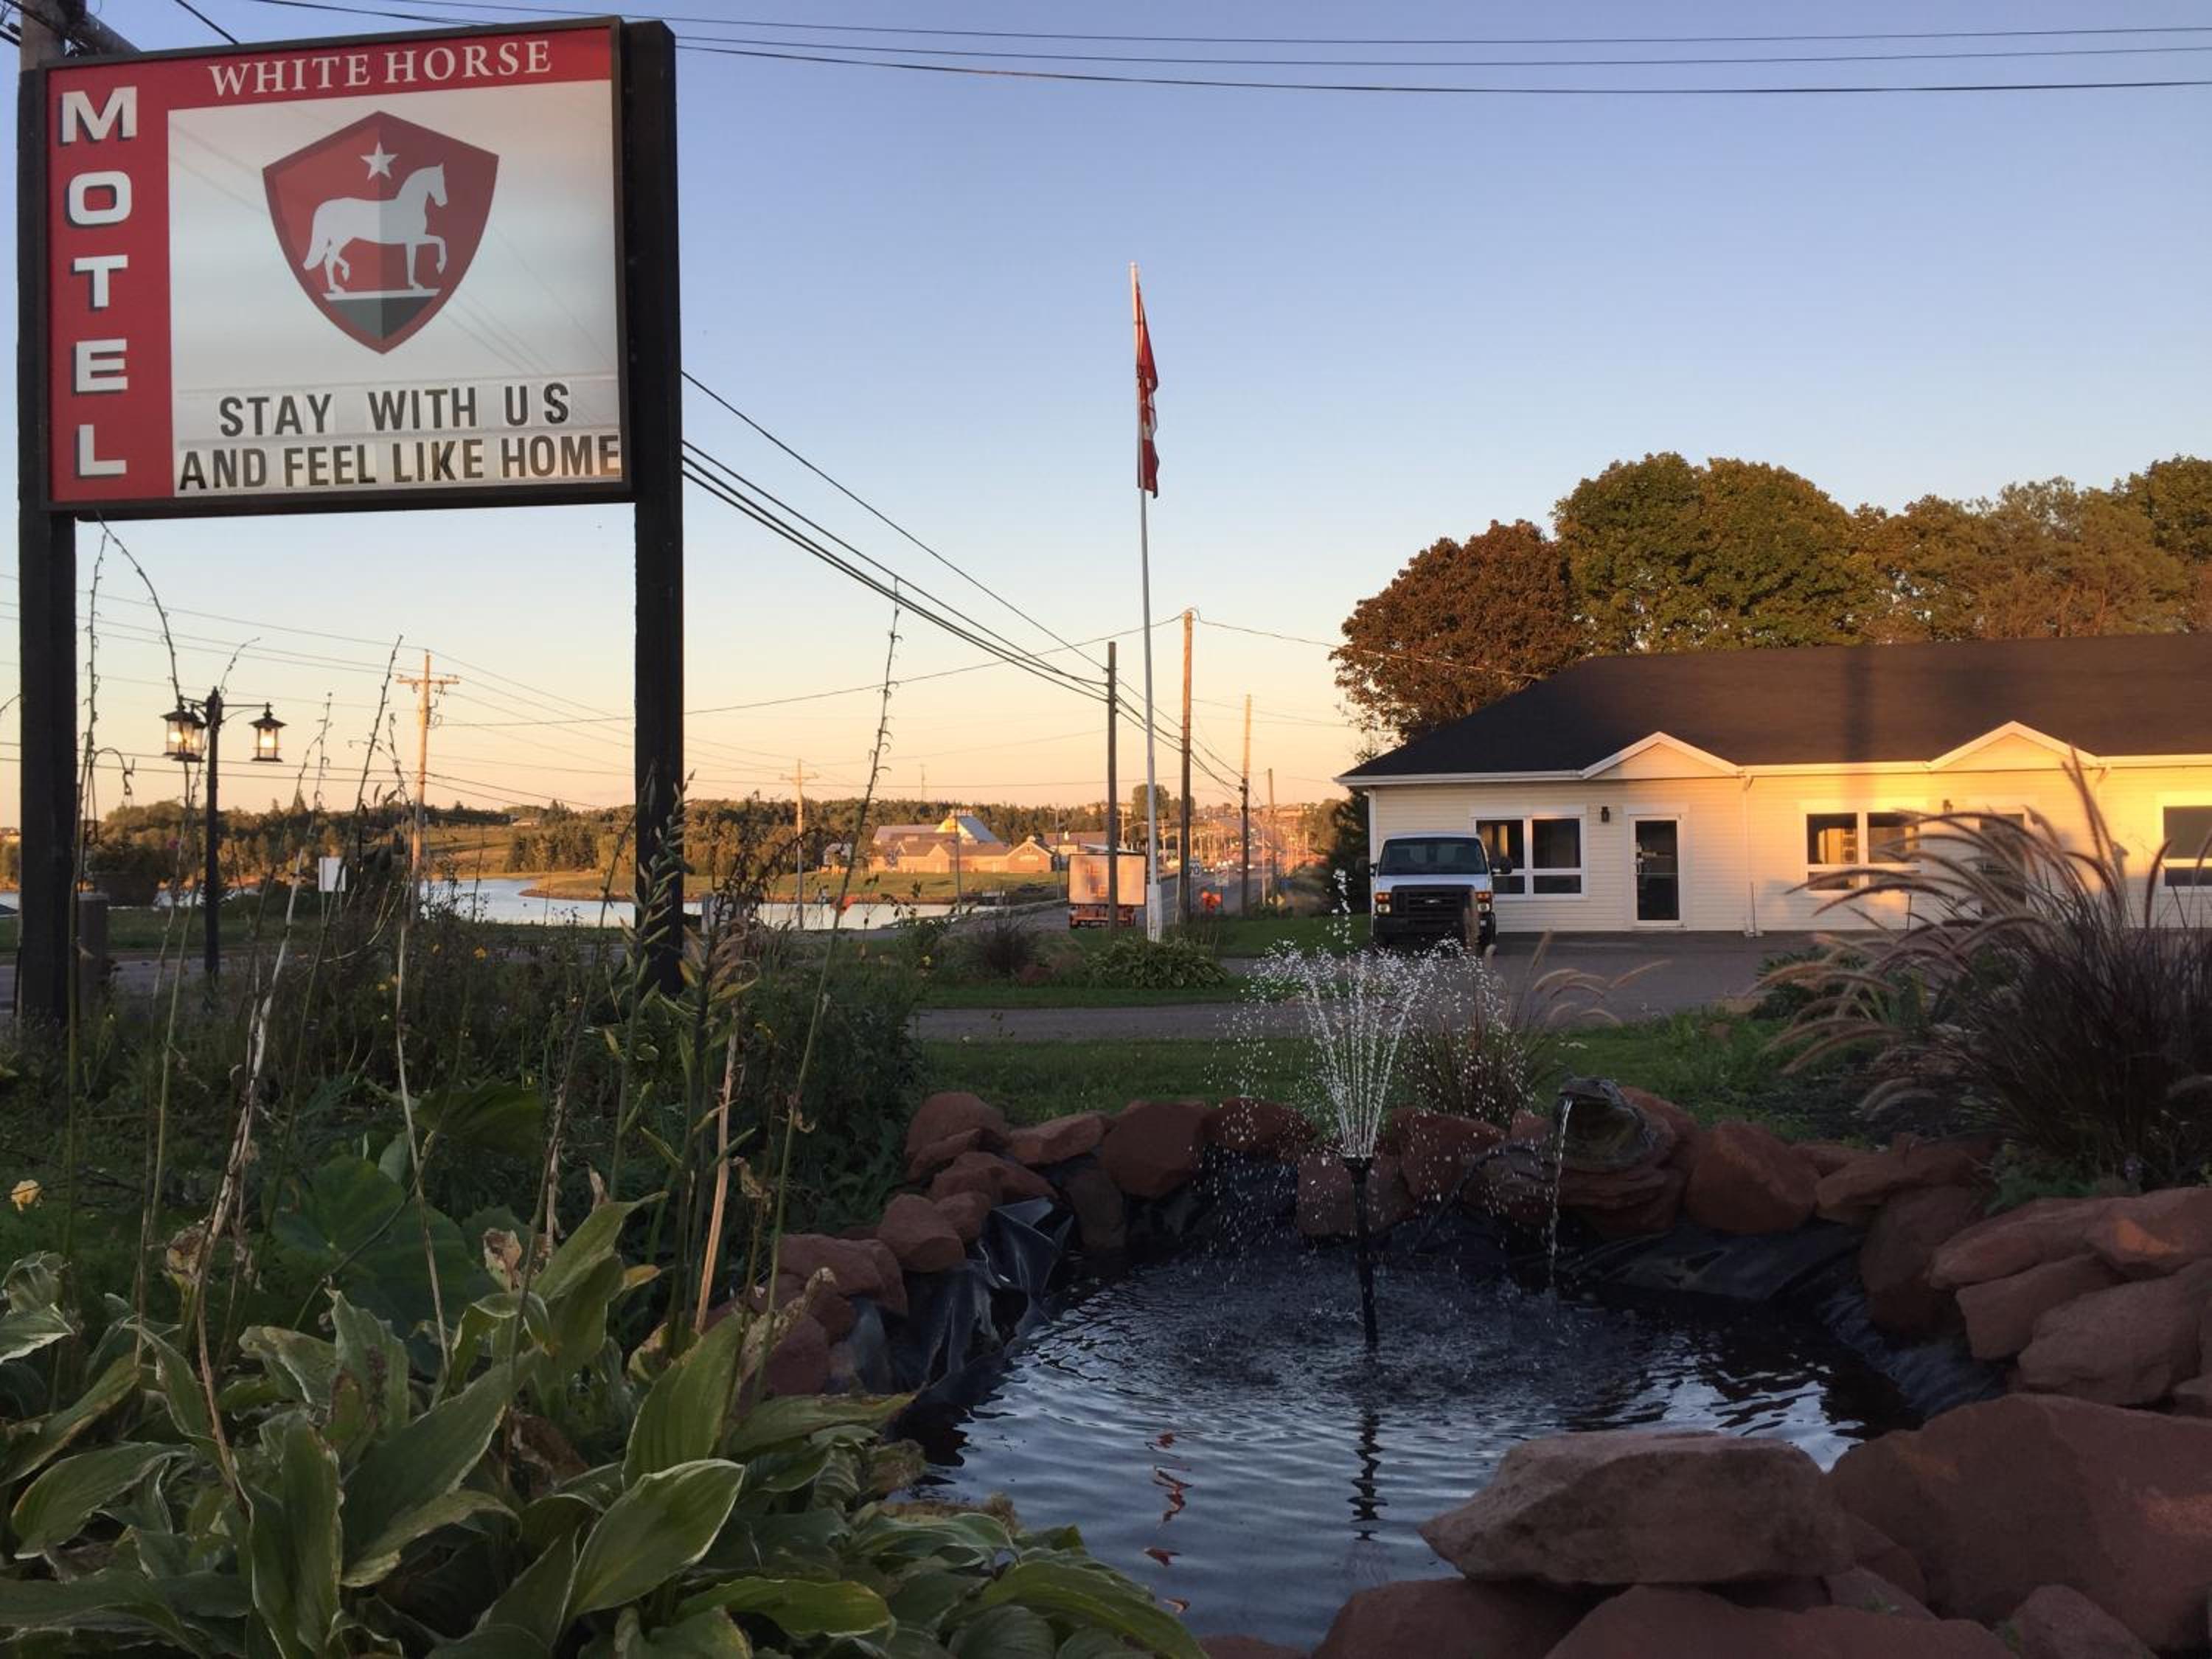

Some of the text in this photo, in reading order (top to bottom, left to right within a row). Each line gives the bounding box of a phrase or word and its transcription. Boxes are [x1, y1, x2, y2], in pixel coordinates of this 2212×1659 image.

[207, 40, 552, 97] WHITE HORSE
[61, 86, 138, 476] MOTEL
[219, 382, 569, 437] STAY WITH US
[179, 434, 622, 490] AND FEEL LIKE HOME
